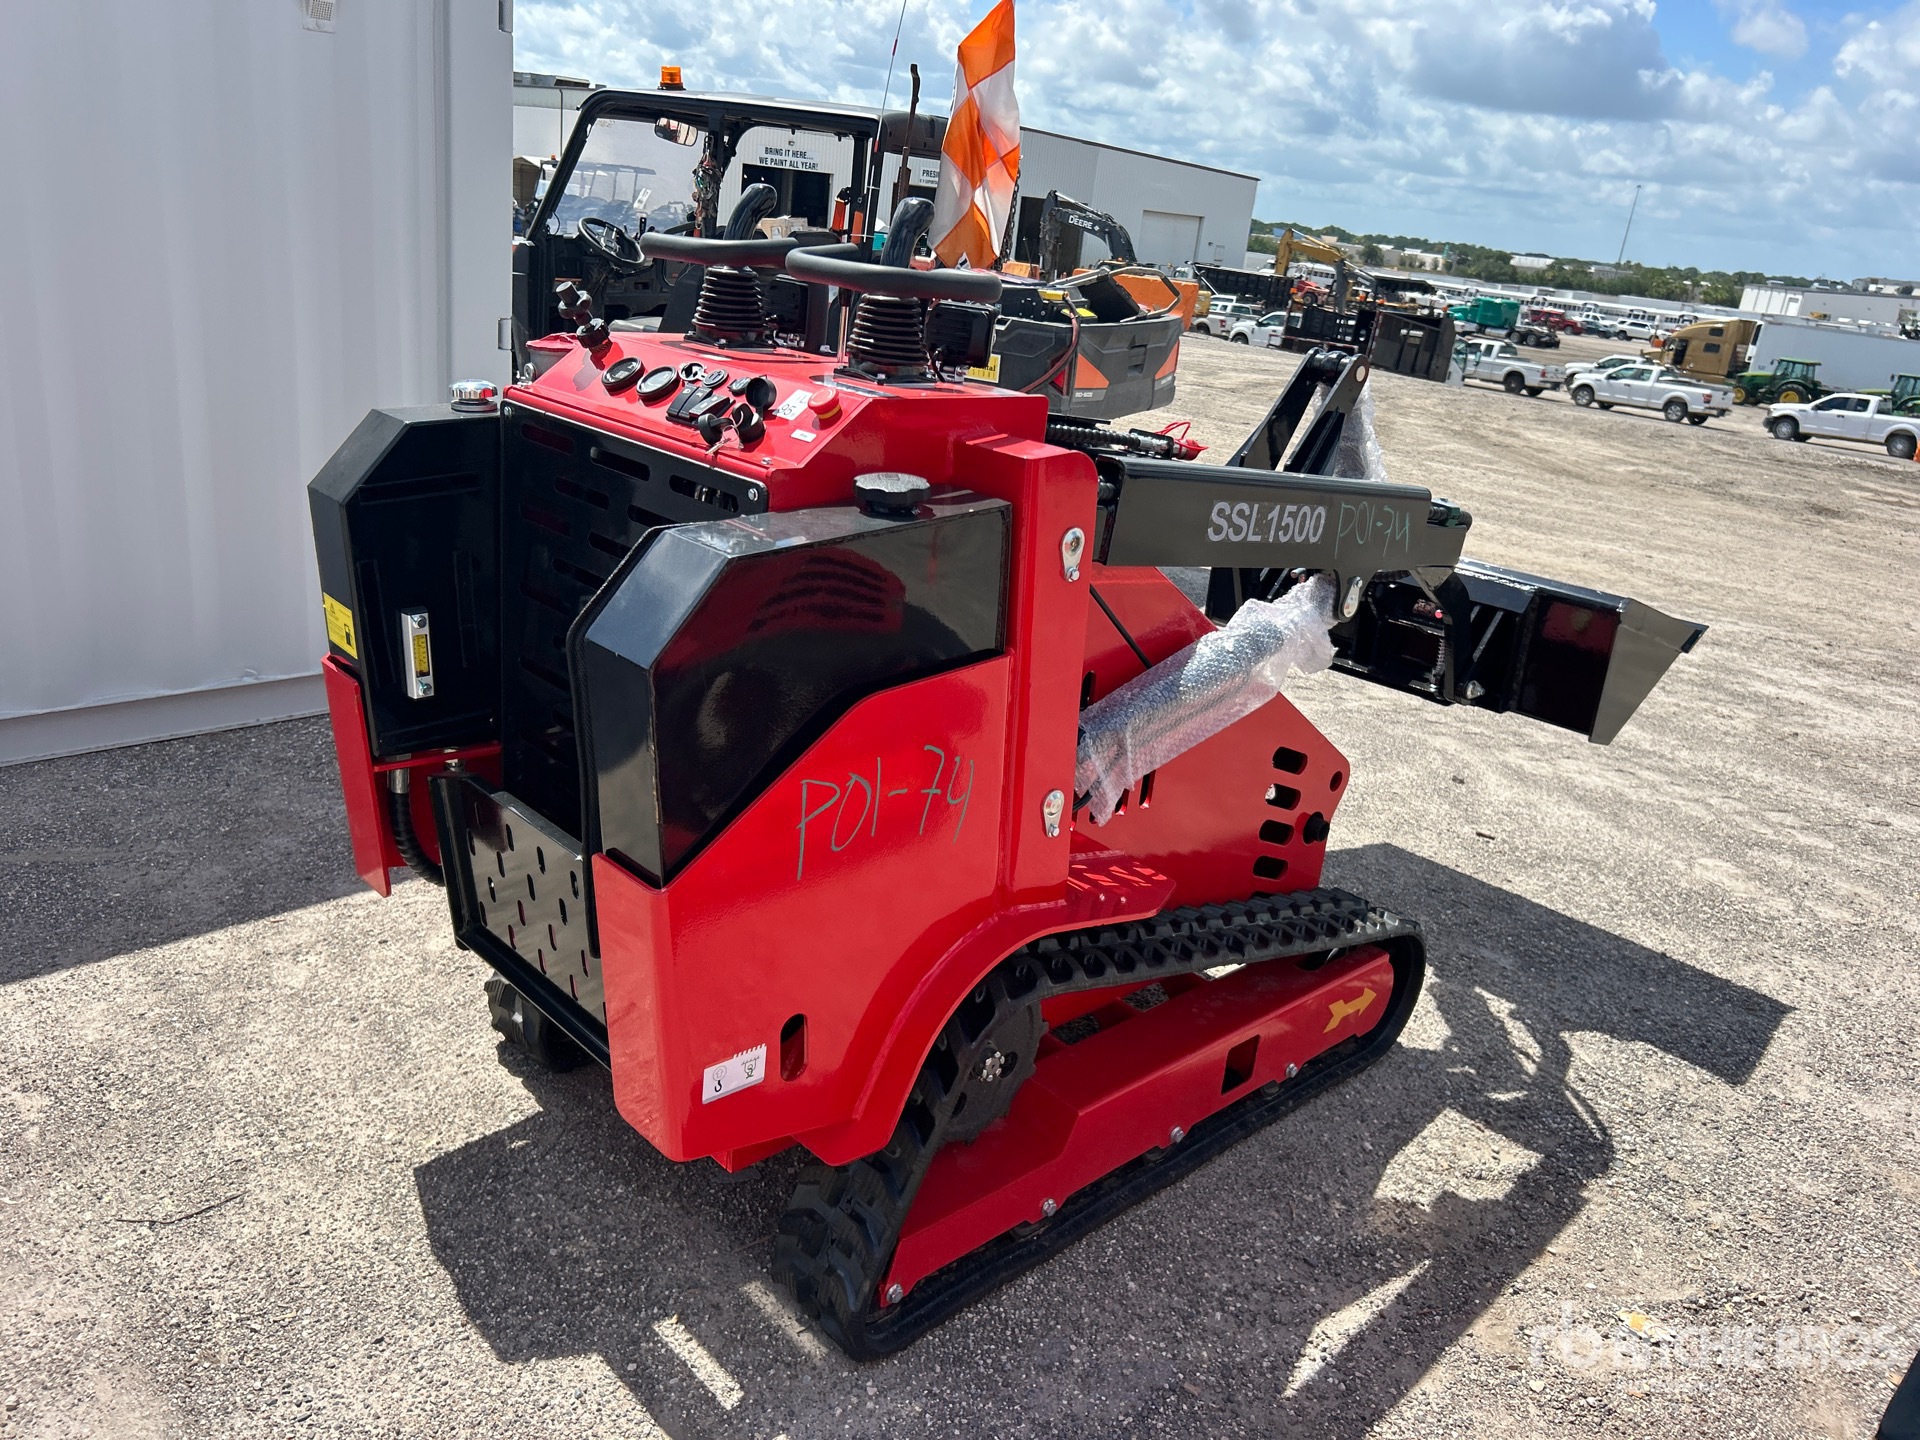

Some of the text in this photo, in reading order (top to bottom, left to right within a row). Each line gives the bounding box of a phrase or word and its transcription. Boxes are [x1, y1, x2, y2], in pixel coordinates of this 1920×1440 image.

[765, 147, 783, 156] BRING
[785, 149, 791, 157] IT
[759, 156, 819, 170] WE PAINT ALL YEAR!
[1069, 215, 1093, 229] DEERE
